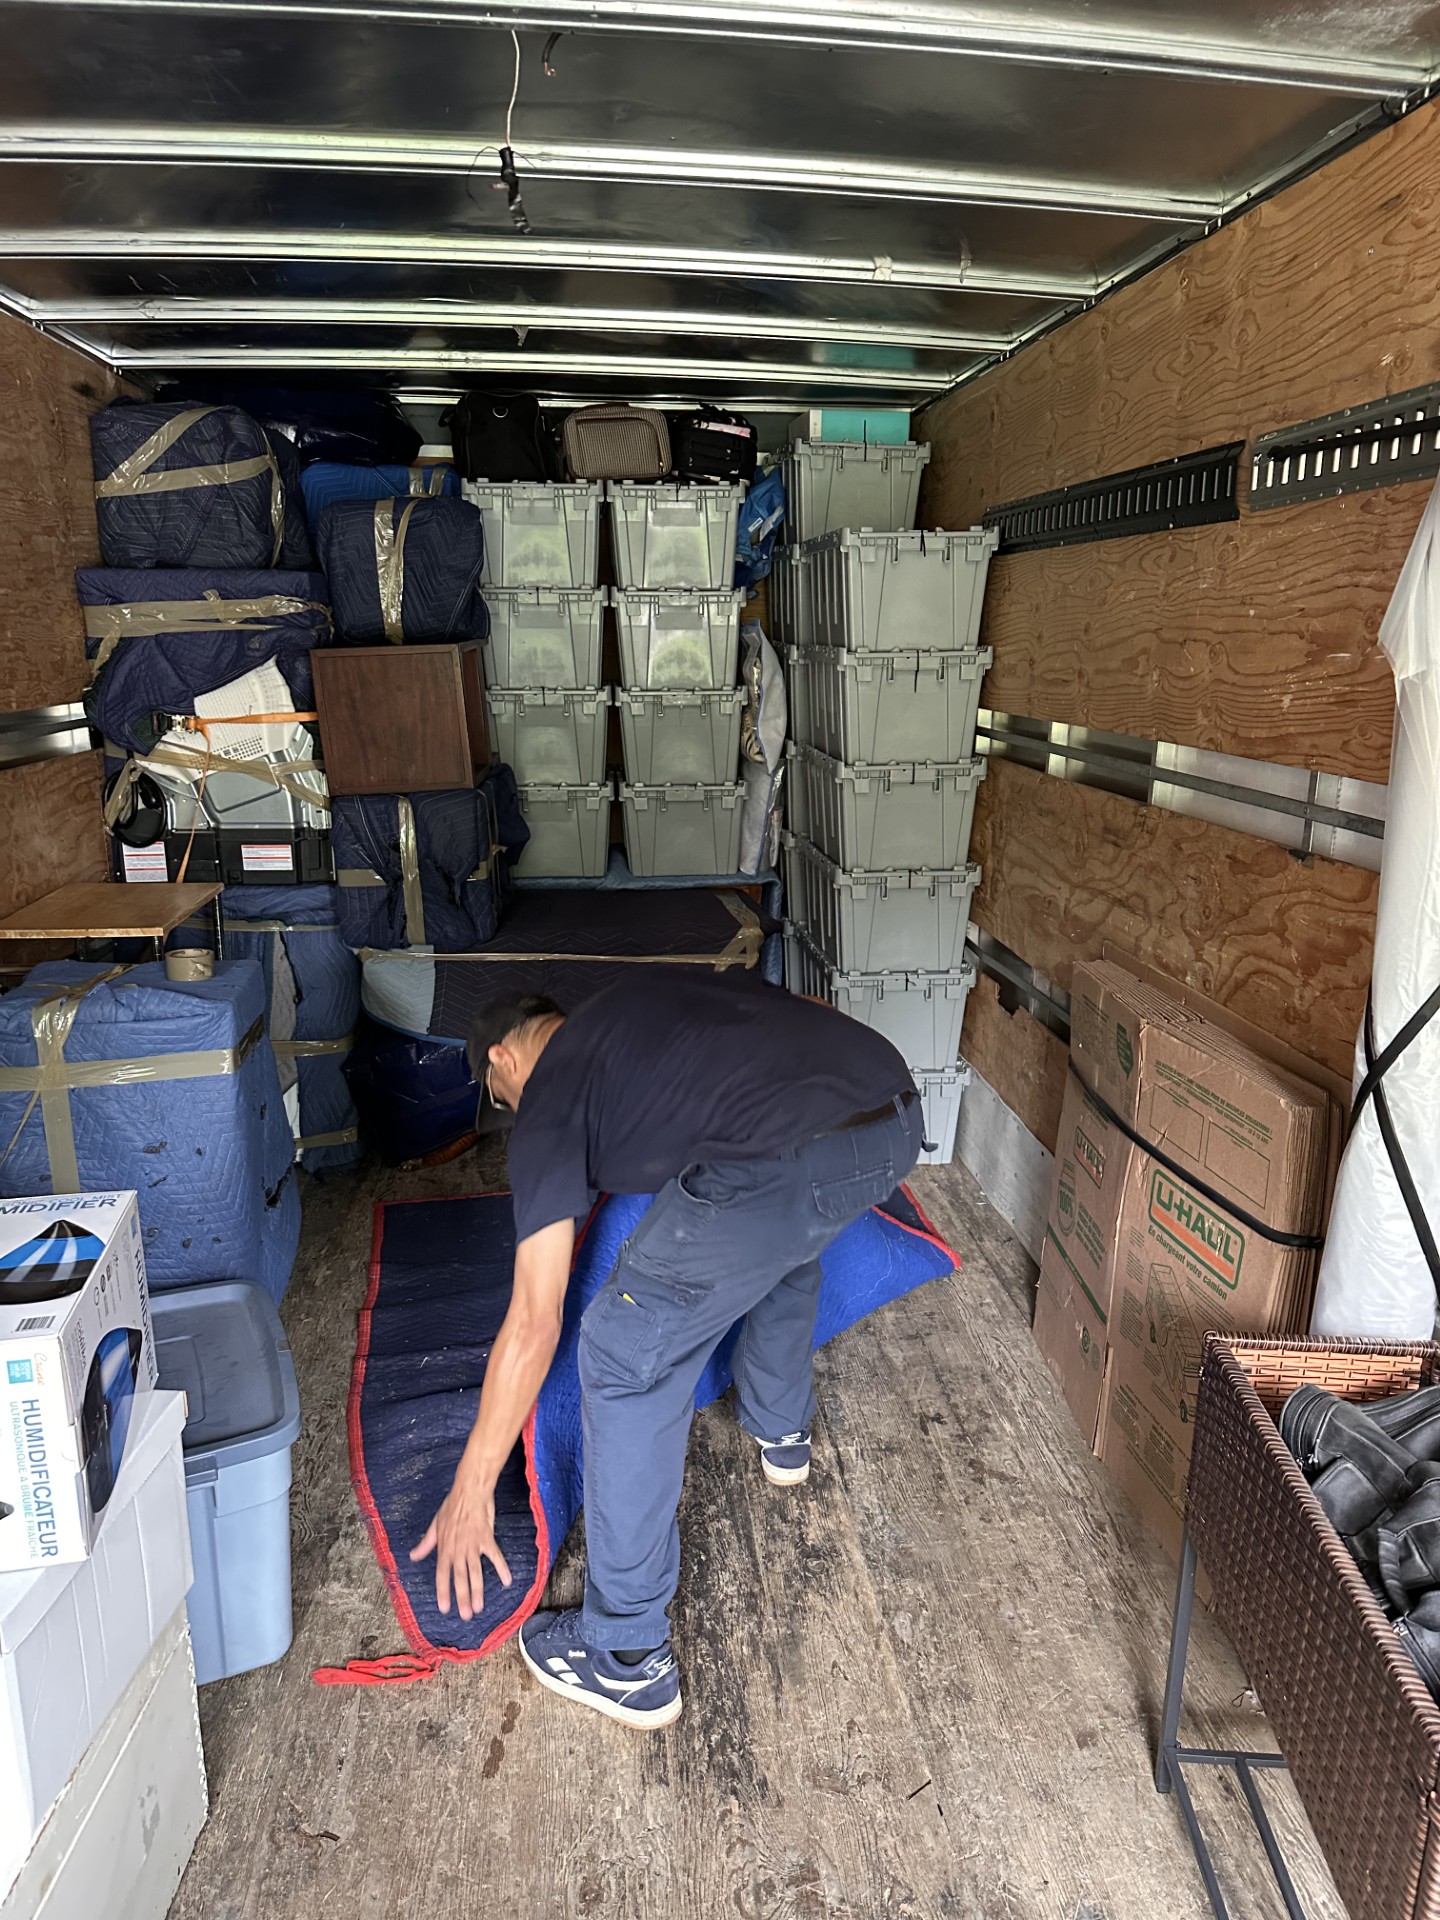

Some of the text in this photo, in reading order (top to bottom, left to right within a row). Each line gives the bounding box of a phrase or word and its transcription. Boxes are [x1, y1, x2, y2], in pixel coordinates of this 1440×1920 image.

[1148, 1225, 1156, 1238] En
[1155, 1232, 1186, 1265] chargeant
[1186, 1260, 1203, 1279] votre
[1202, 1274, 1228, 1301] camion
[1156, 1180, 1235, 1265] U-HAUL
[9, 1401, 28, 1474] ULTRASONIQUE
[21, 1484, 34, 1519] BRUME
[22, 1399, 59, 1558] HUMIDIFICATEUR
